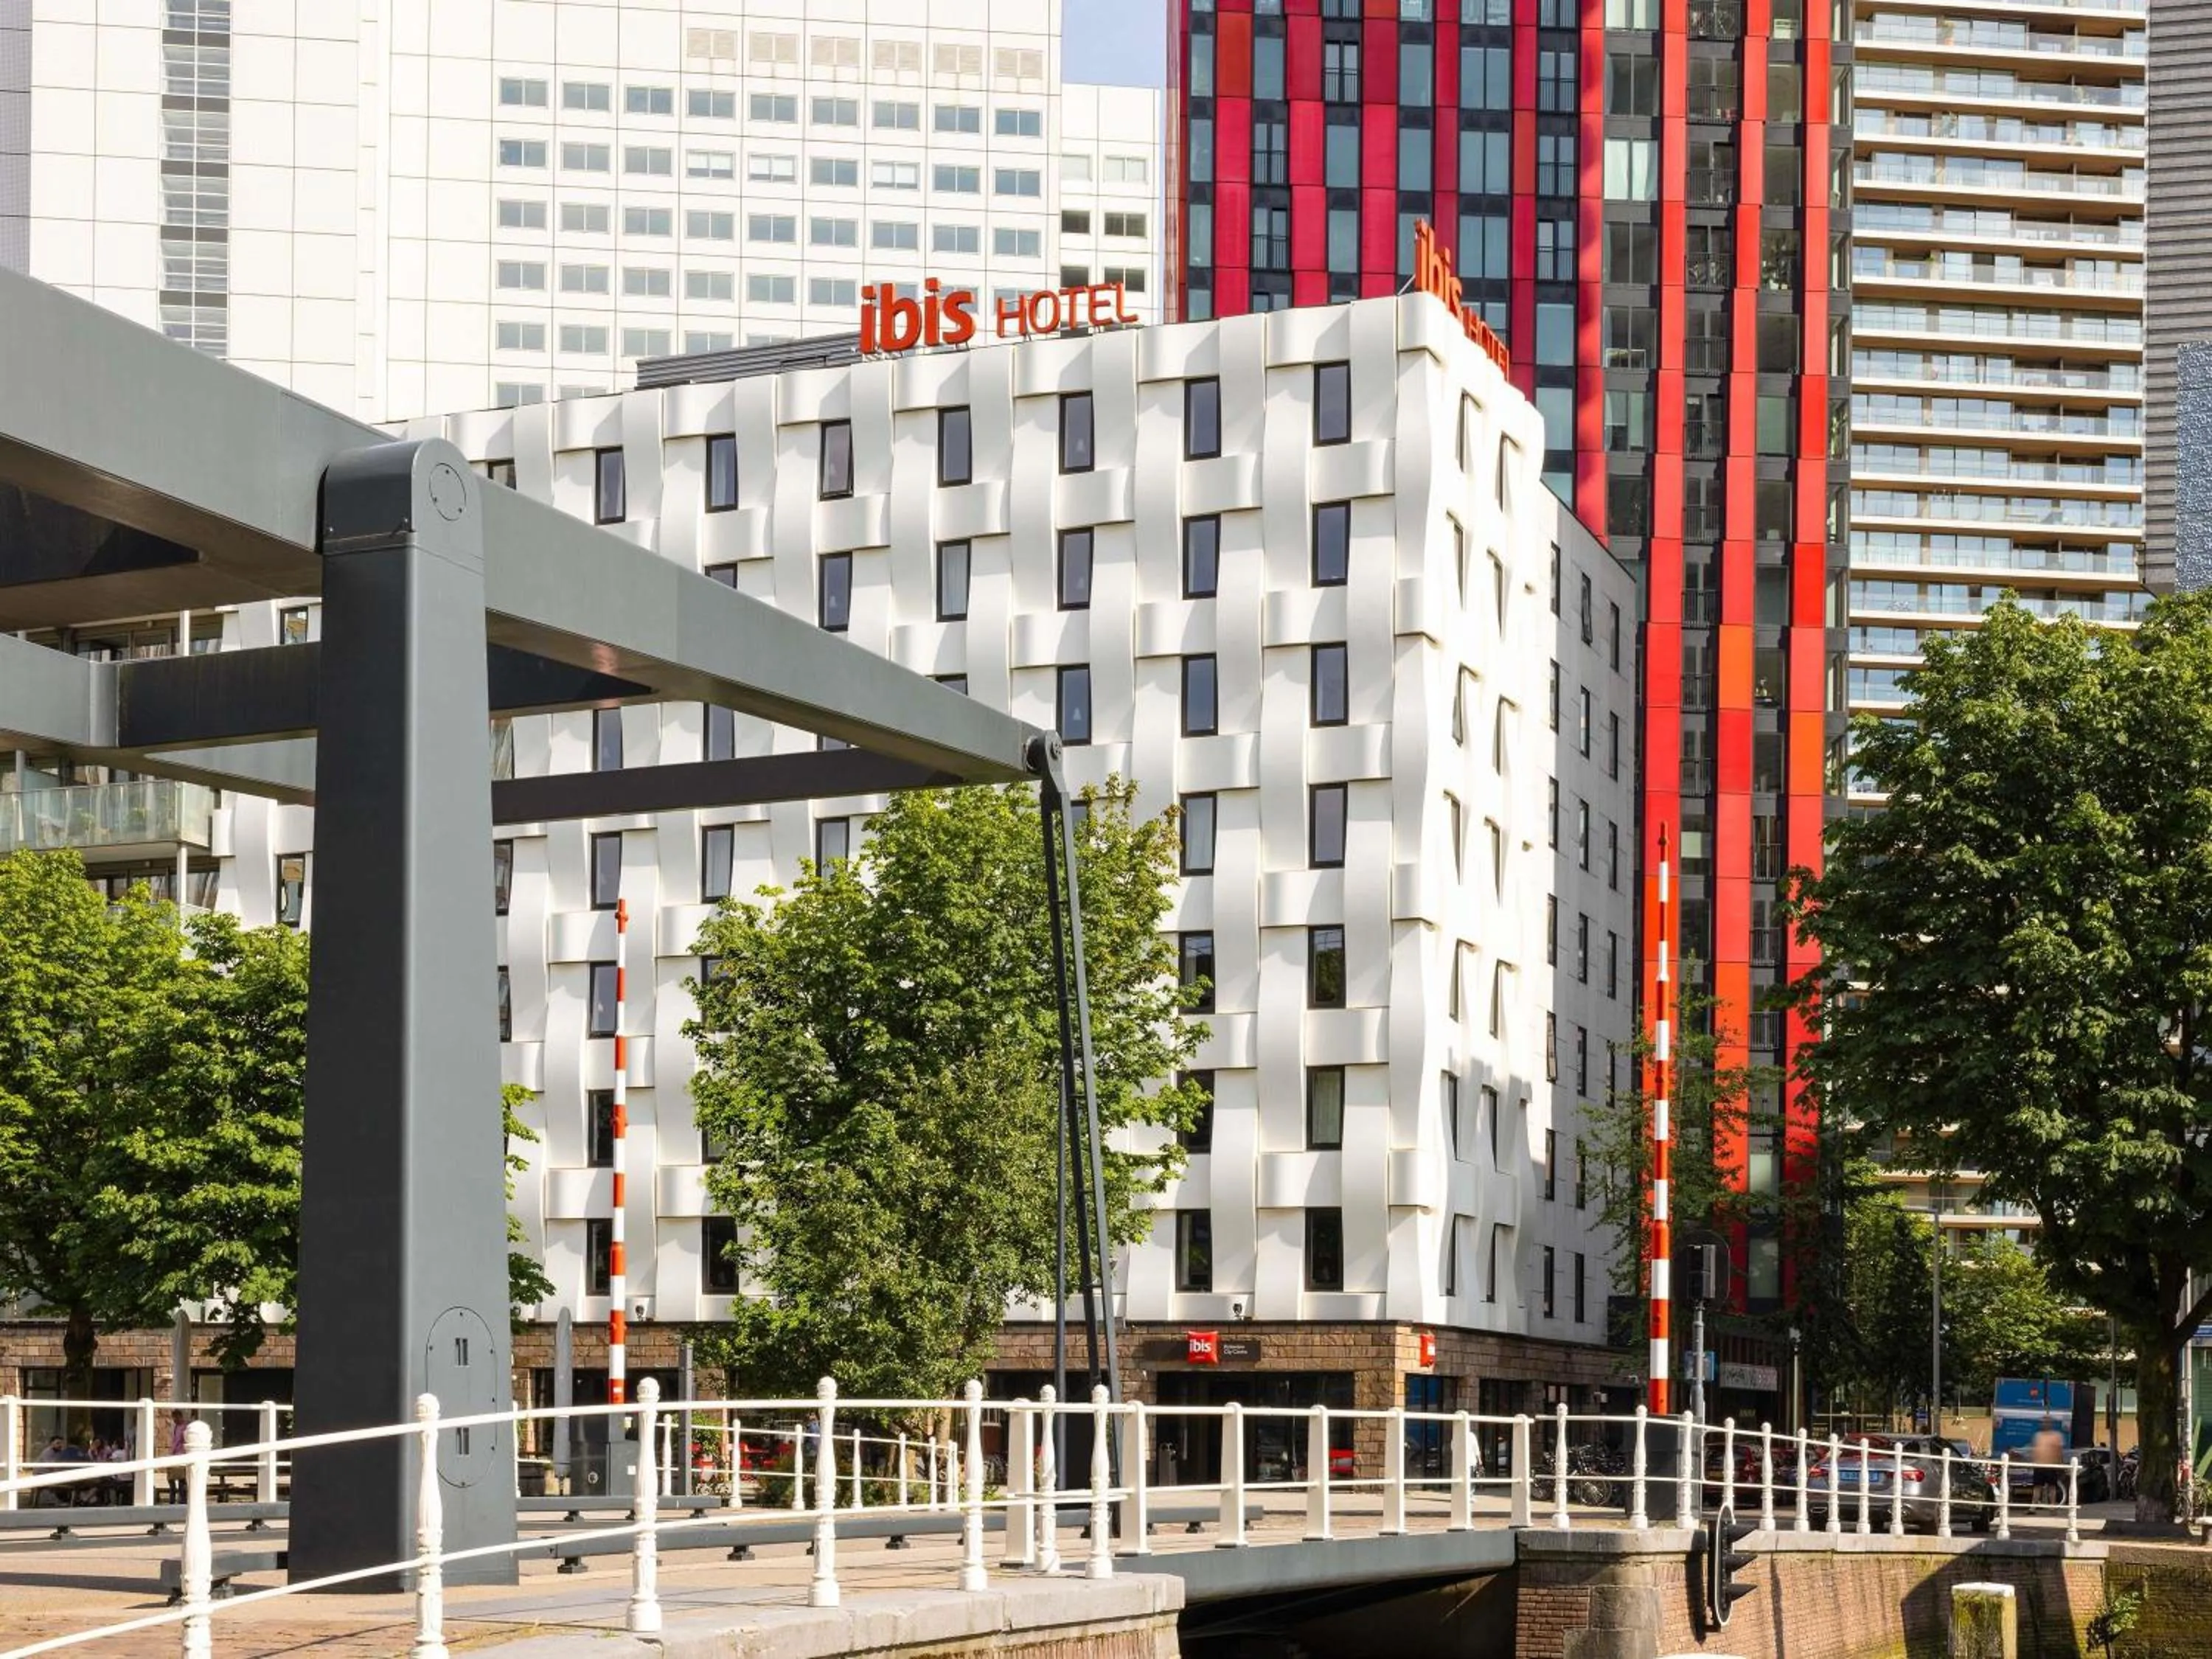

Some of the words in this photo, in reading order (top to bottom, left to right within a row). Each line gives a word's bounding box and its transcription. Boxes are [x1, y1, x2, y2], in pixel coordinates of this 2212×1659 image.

[1414, 218, 1462, 322] ibis
[860, 277, 975, 353] ibis
[997, 281, 1138, 338] HOTEL
[1189, 1339, 1211, 1353] ibis
